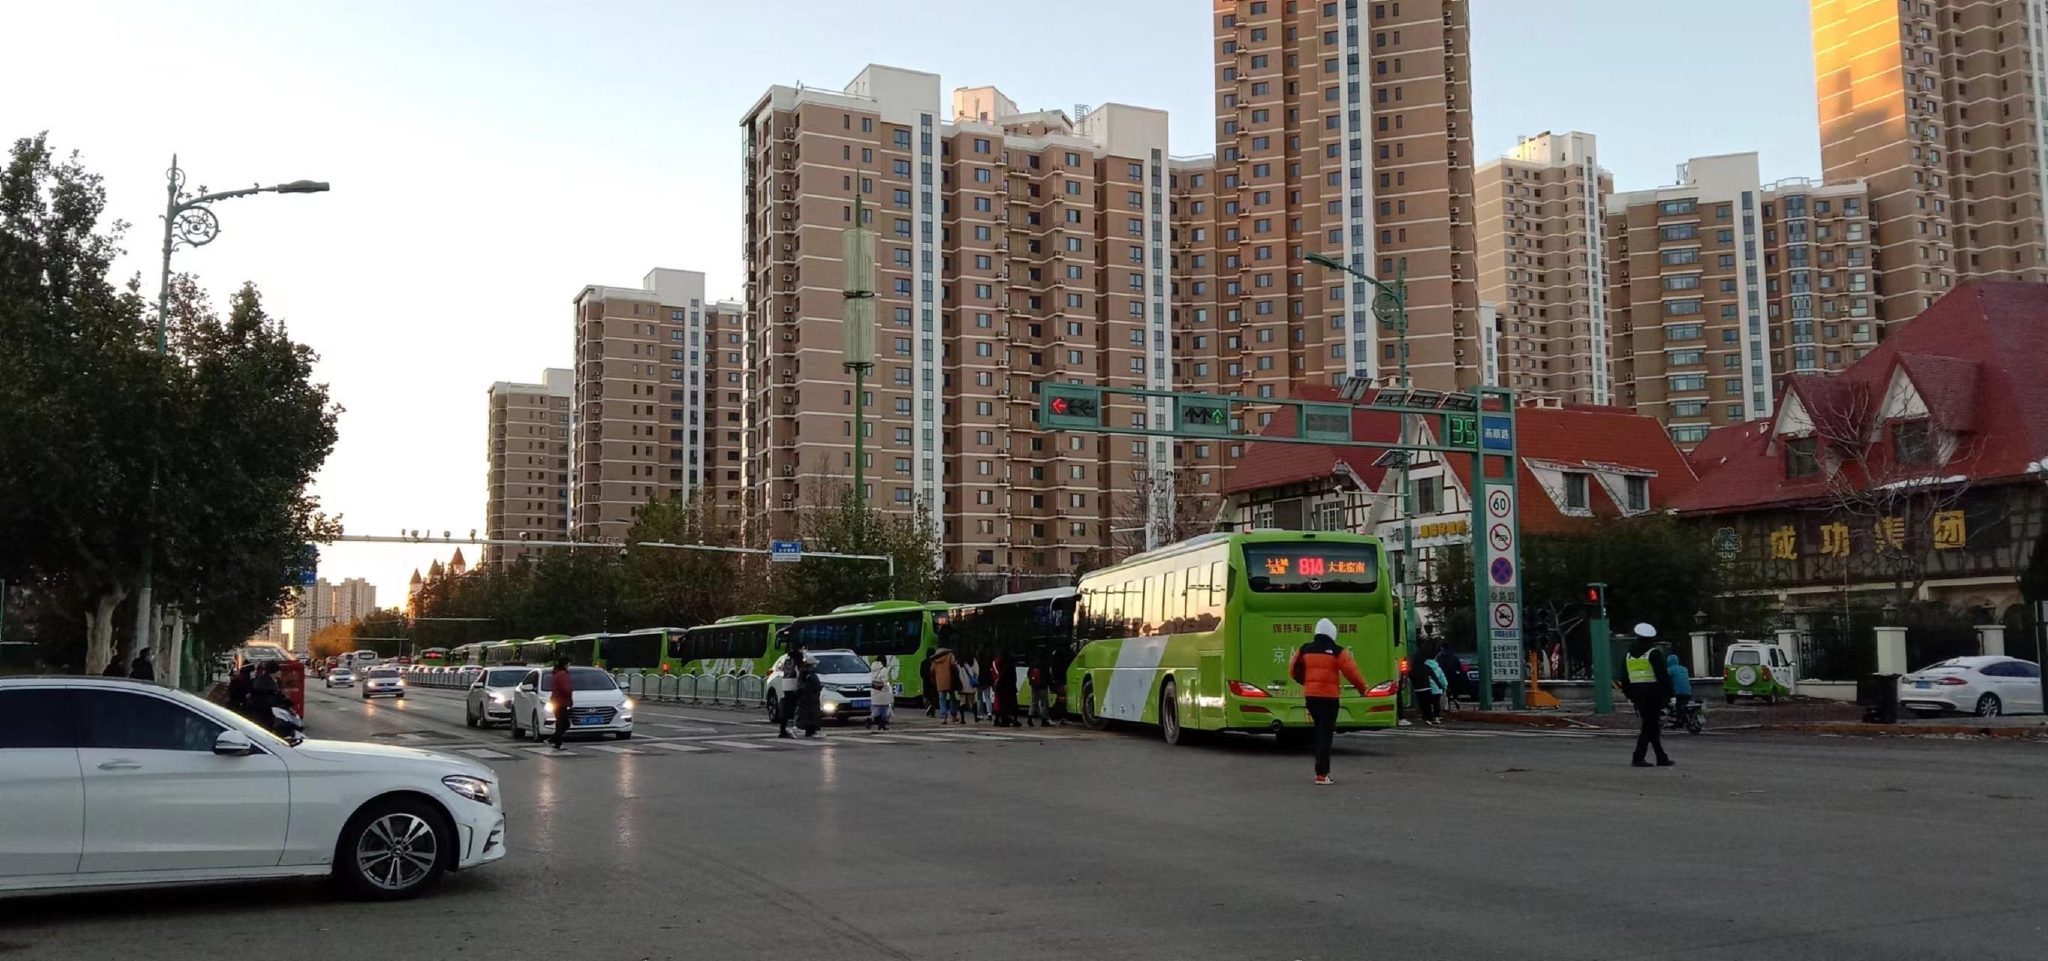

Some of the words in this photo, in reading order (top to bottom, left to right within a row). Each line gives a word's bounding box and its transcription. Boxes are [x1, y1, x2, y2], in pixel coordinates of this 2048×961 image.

[1452, 418, 1477, 444] 35
[1493, 498, 1506, 510] 60
[1769, 510, 1967, 560] 成功集团
[1299, 557, 1324, 576] 814
